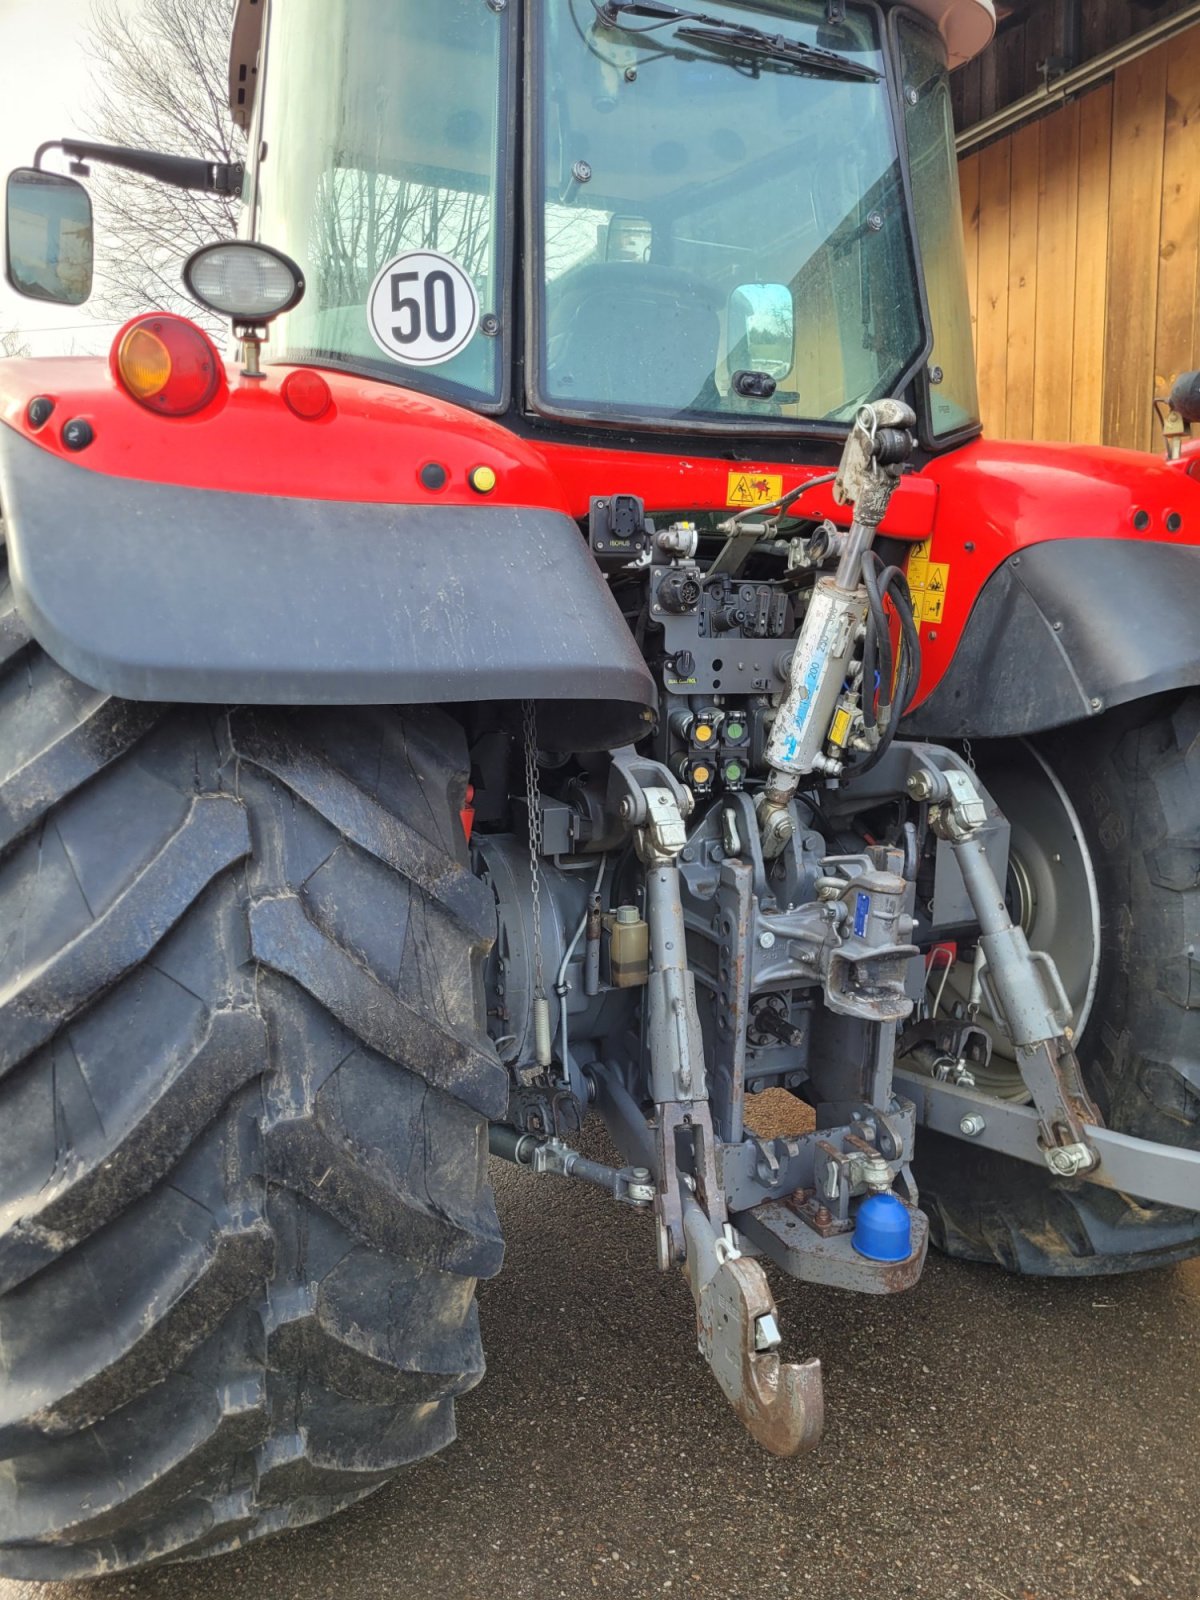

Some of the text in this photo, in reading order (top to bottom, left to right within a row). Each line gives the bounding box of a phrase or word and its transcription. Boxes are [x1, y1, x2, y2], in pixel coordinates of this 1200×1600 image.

[391, 270, 456, 344] 50
[807, 661, 820, 680] 200
[816, 634, 829, 652] 250
